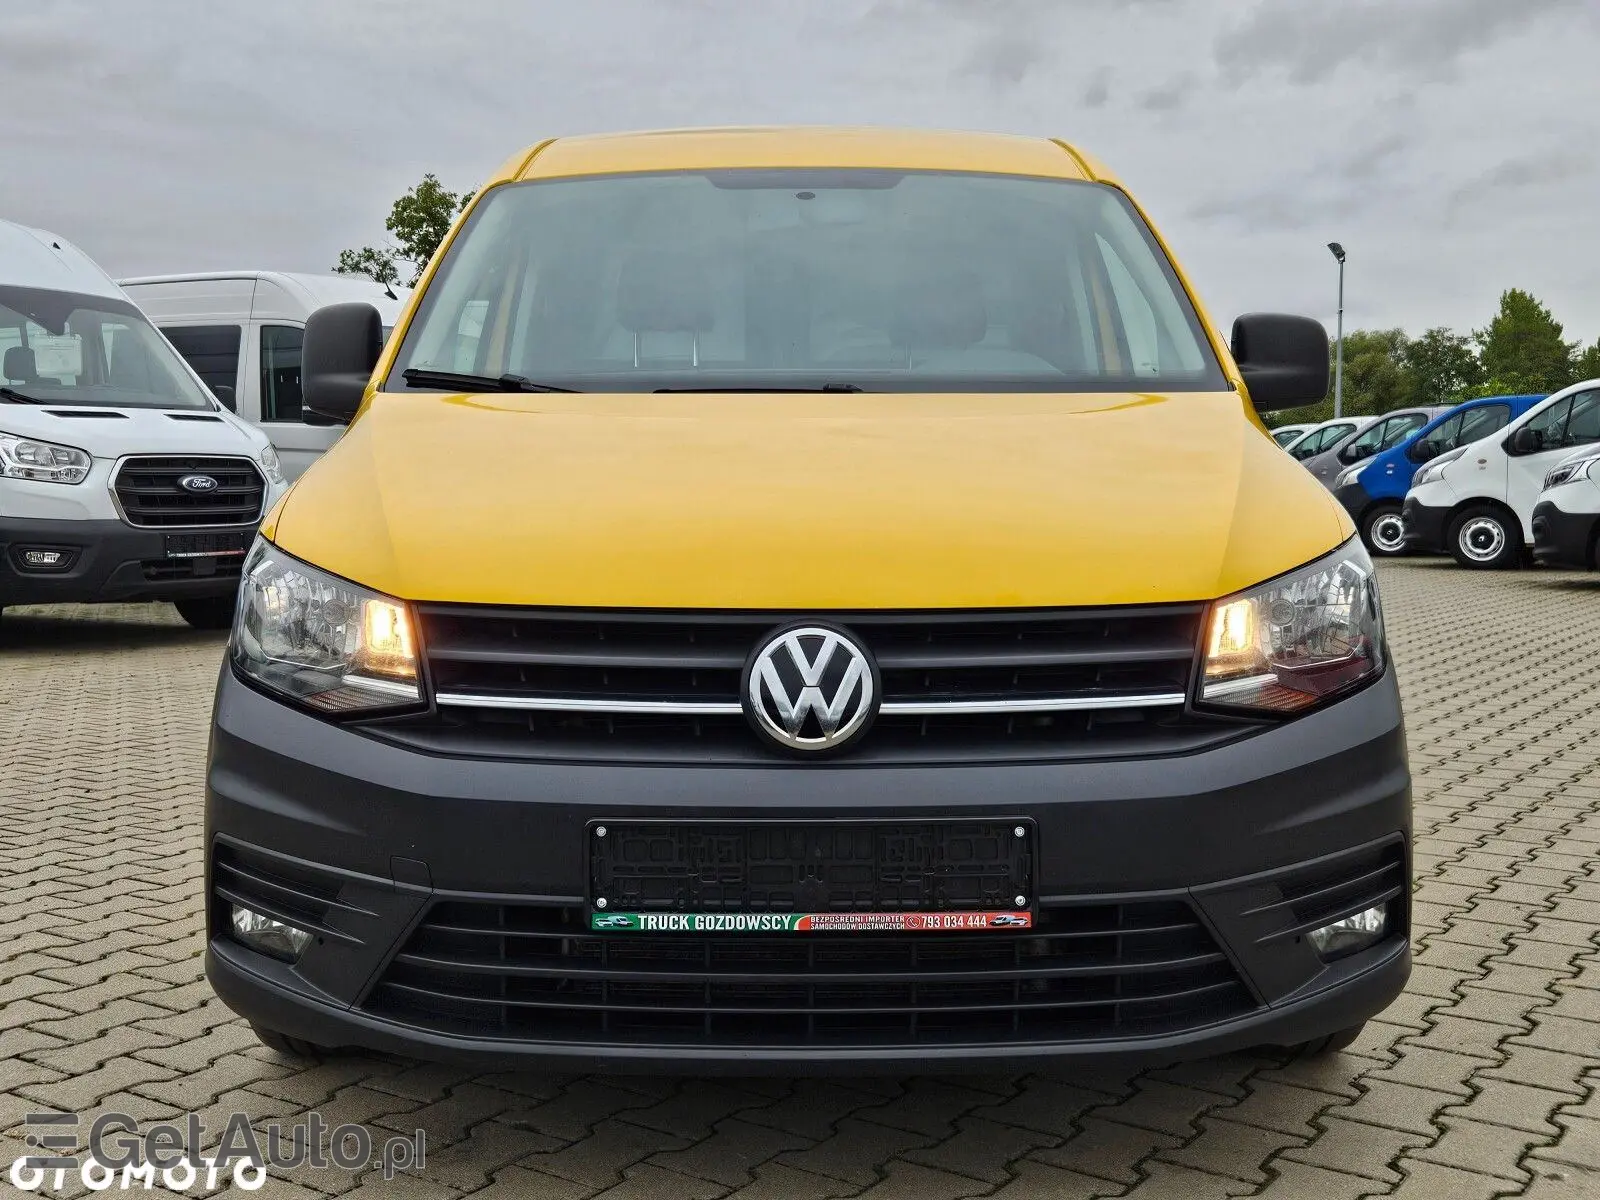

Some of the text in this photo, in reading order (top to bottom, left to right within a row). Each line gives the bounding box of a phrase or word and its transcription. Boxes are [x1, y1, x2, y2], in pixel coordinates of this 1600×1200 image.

[192, 478, 212, 488] Ford
[638, 914, 792, 930] TRUCK GOZDOWSCY
[858, 922, 905, 930] DOSTAWCZYCH
[922, 914, 987, 928] 793 034 444
